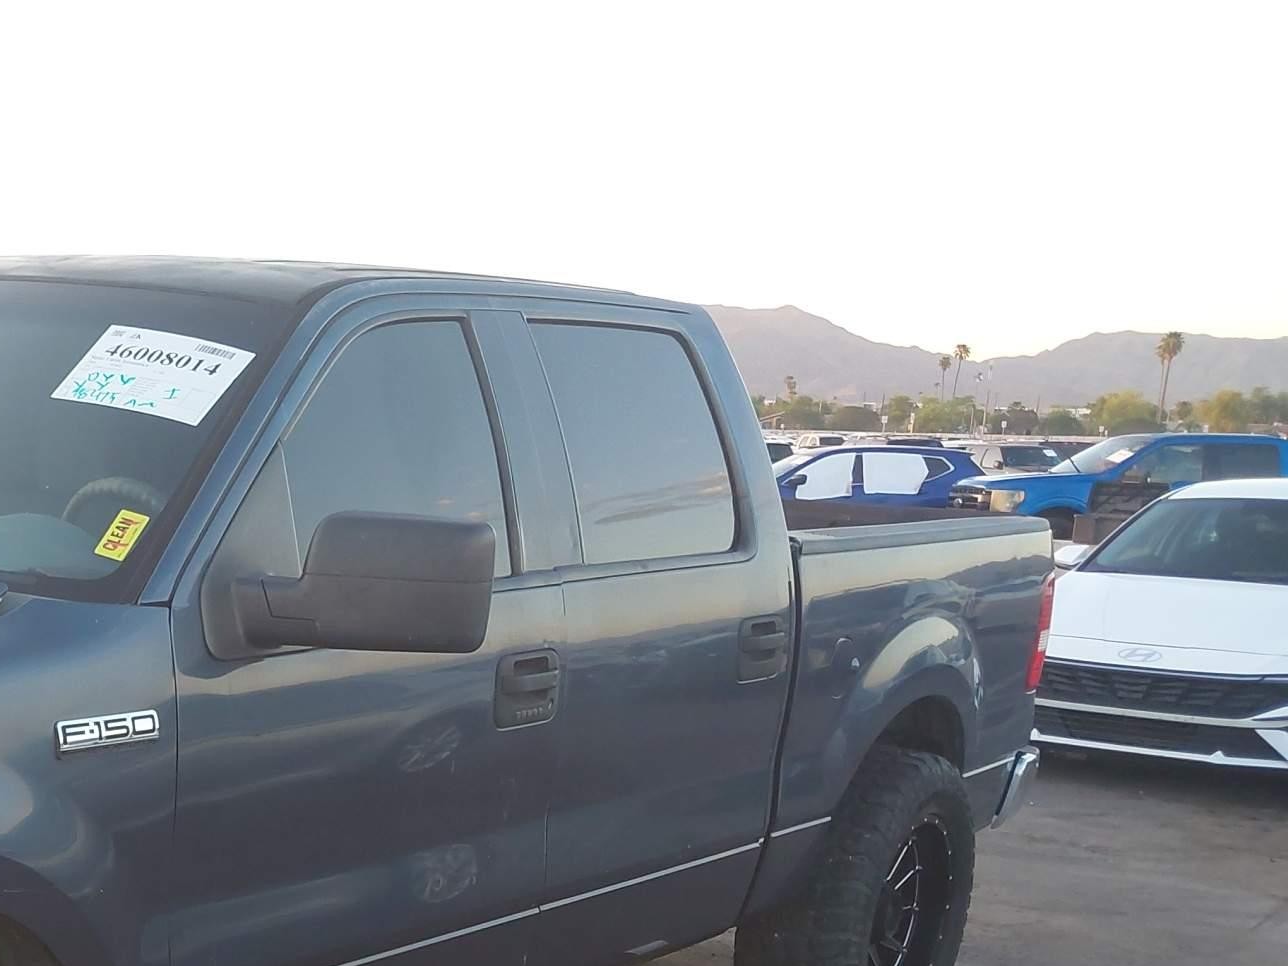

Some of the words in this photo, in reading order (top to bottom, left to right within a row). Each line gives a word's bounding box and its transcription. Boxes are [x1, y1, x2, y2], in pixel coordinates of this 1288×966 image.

[105, 343, 223, 376] 46008014
[102, 517, 135, 551] CLEAN
[60, 714, 156, 745] F-150
